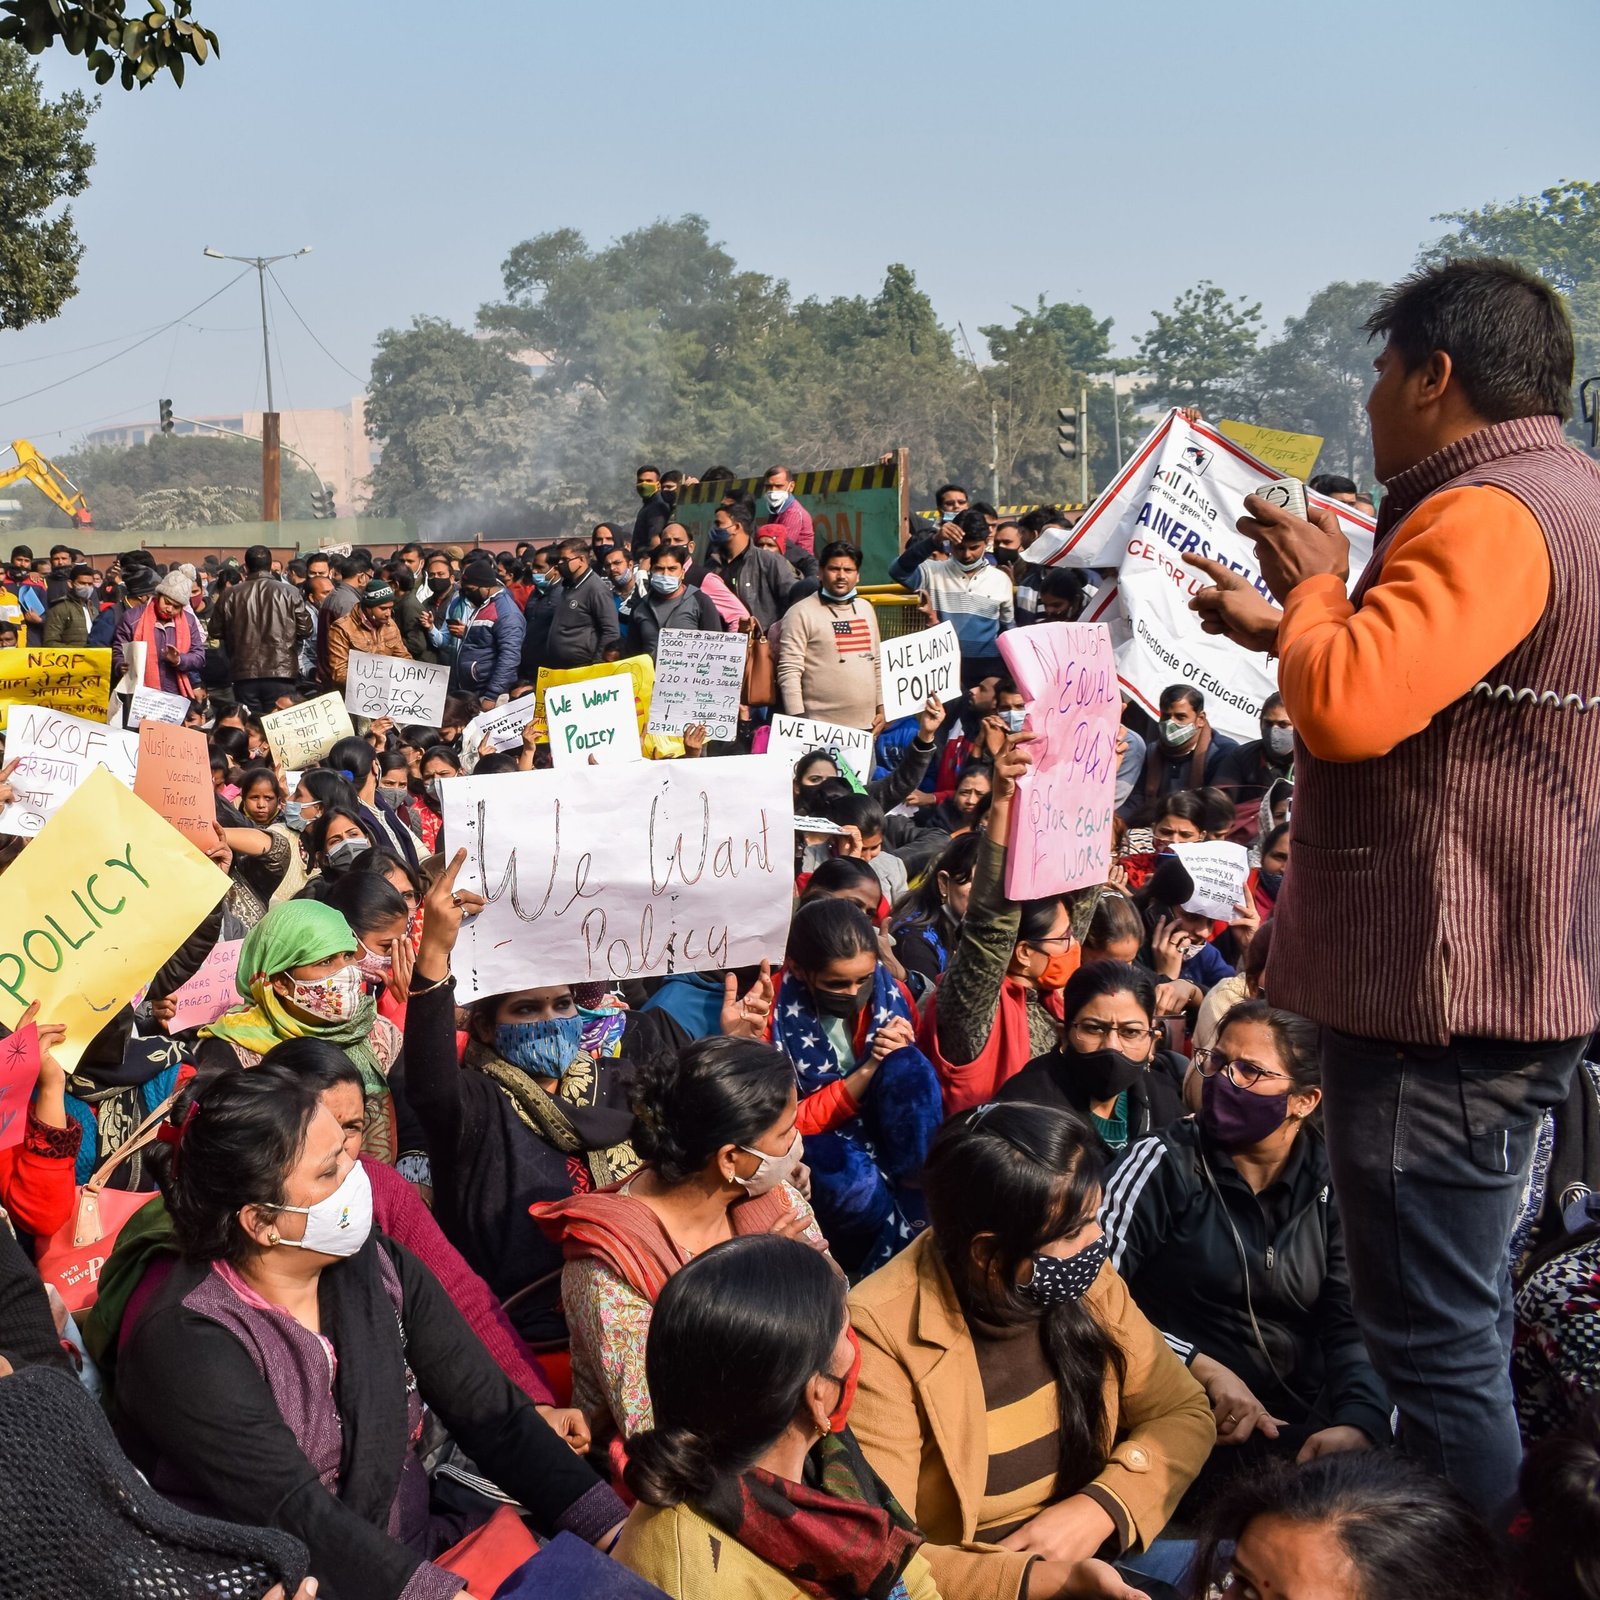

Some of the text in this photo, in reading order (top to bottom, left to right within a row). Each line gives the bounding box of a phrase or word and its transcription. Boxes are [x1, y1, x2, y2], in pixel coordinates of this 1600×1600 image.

[1183, 482, 1217, 521] India
[1158, 553, 1185, 587] FOR
[27, 652, 85, 669] NSQF
[887, 630, 955, 673] WE WANT
[1136, 618, 1180, 670] Directorate
[1182, 662, 1200, 682] Of
[356, 659, 440, 685] WE WANT
[896, 661, 952, 707] POLICY
[1059, 660, 1115, 714] EQUAL
[356, 682, 425, 707] POLICY
[549, 694, 572, 717] WE
[582, 689, 619, 709] WANT
[482, 718, 509, 734] POLICY
[497, 719, 523, 735] POLICY
[564, 724, 615, 754] POLICY
[779, 719, 870, 750] WE WANT
[1068, 721, 1118, 785] PAY
[477, 790, 775, 922] We Want
[1063, 845, 1105, 882] WORK
[0, 842, 150, 1007] POLICY
[580, 902, 729, 979] Policy
[67, 1268, 90, 1287] have
